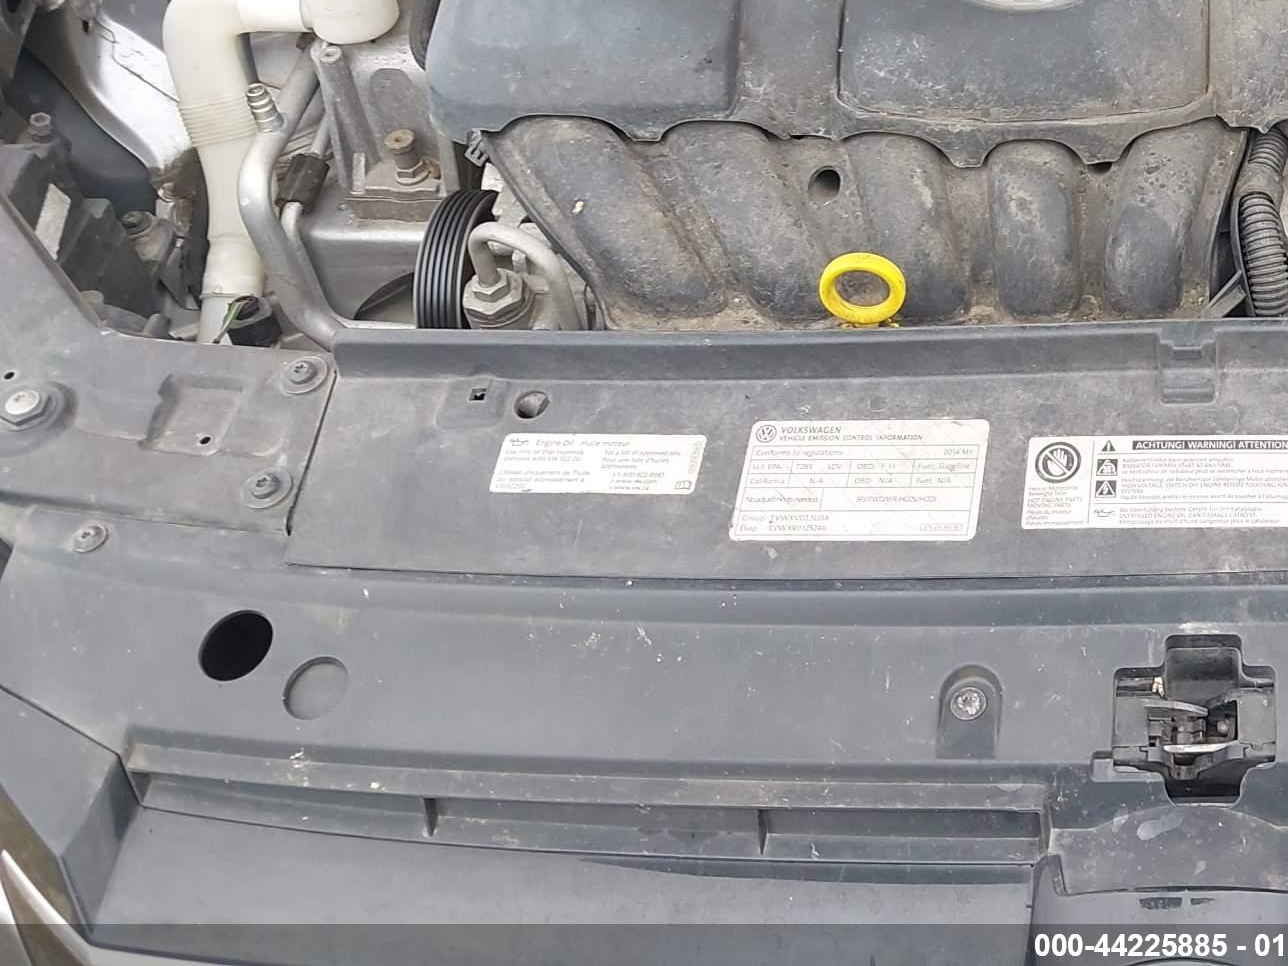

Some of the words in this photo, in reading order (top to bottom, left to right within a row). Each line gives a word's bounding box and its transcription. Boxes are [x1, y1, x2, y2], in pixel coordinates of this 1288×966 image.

[781, 426, 842, 434] VOLKSWAGEN
[779, 434, 806, 442] VEHICLE
[807, 434, 841, 442] EMISSION
[843, 434, 873, 442] CONTROL
[876, 434, 923, 442] INFORMATION
[536, 439, 562, 448] Engine
[602, 439, 632, 448] moteur
[1135, 441, 1185, 450] ACHTUNG!
[1187, 441, 1237, 450] WARNING!
